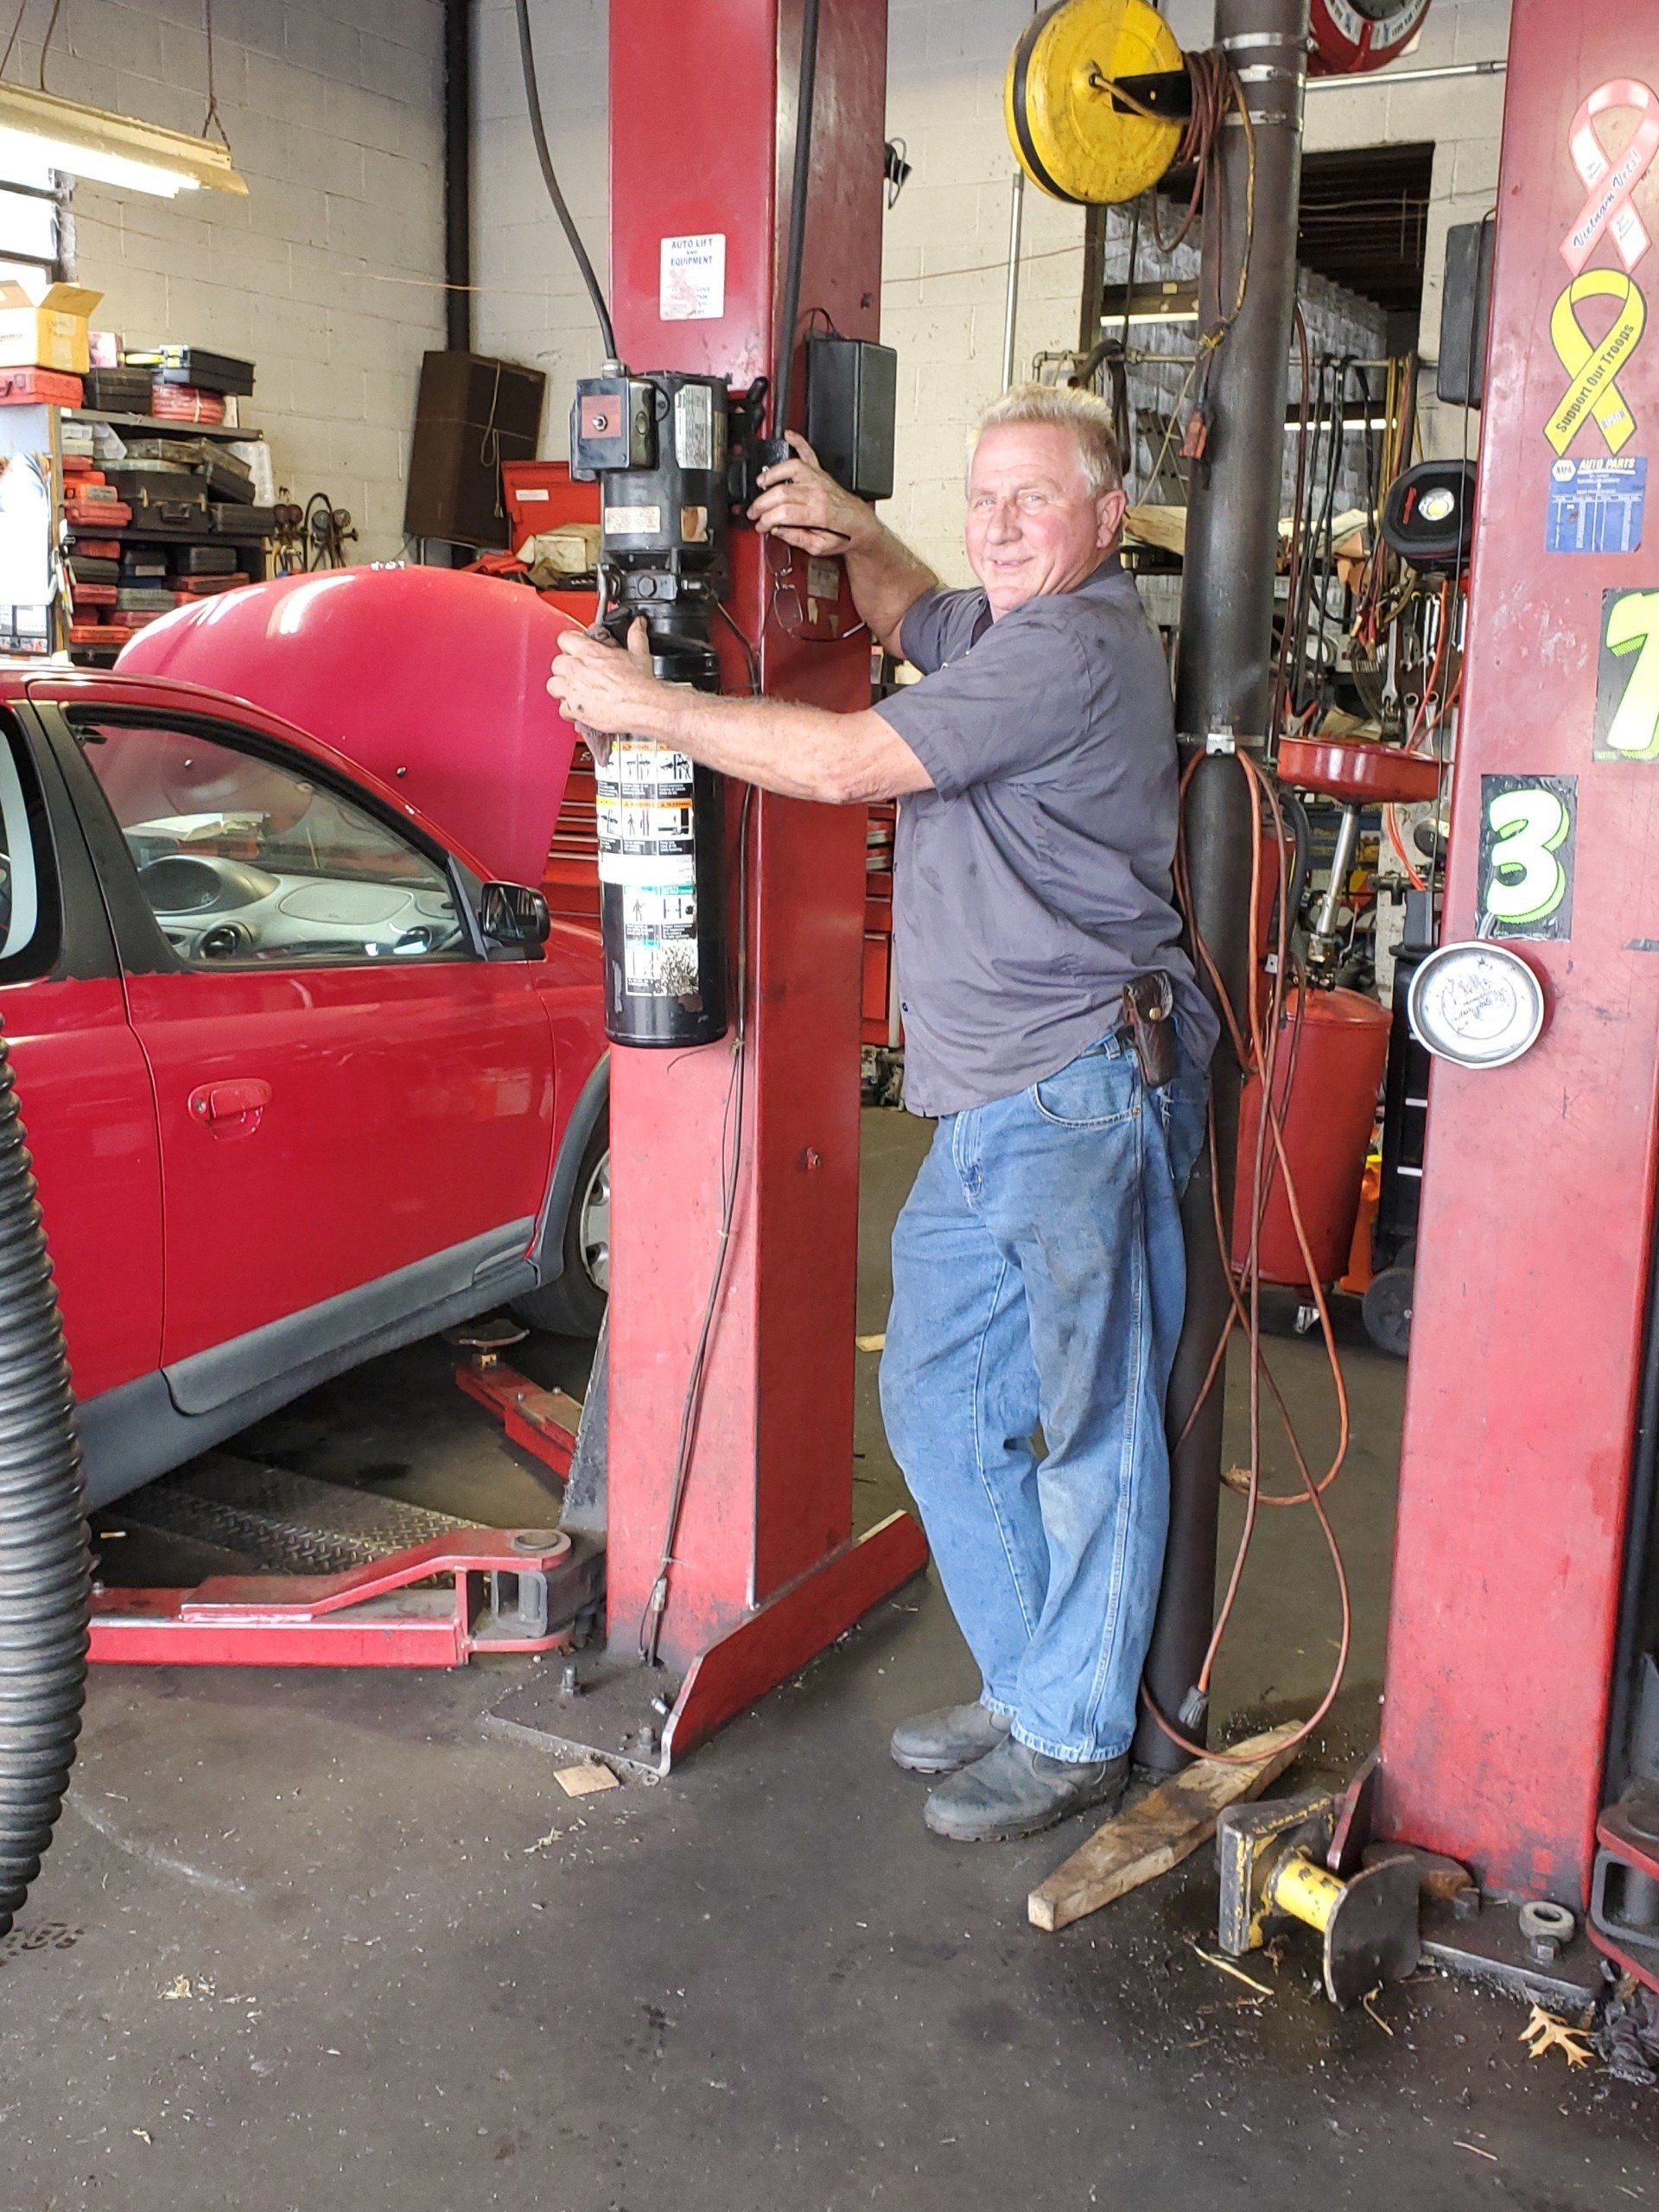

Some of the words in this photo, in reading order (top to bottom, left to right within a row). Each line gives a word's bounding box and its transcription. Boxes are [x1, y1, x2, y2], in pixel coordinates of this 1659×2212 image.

[1573, 192, 1615, 247] Vietnam
[671, 239, 693, 249] AUTO
[696, 238, 713, 247] LIFT
[671, 256, 713, 266] EQUIPMENT
[1555, 385, 1592, 433] Support
[1586, 364, 1606, 387] Our
[1599, 323, 1635, 365] Troops
[1580, 458, 1605, 470] AUTO
[1605, 456, 1636, 469] PARTS
[1487, 788, 1570, 925] 3
